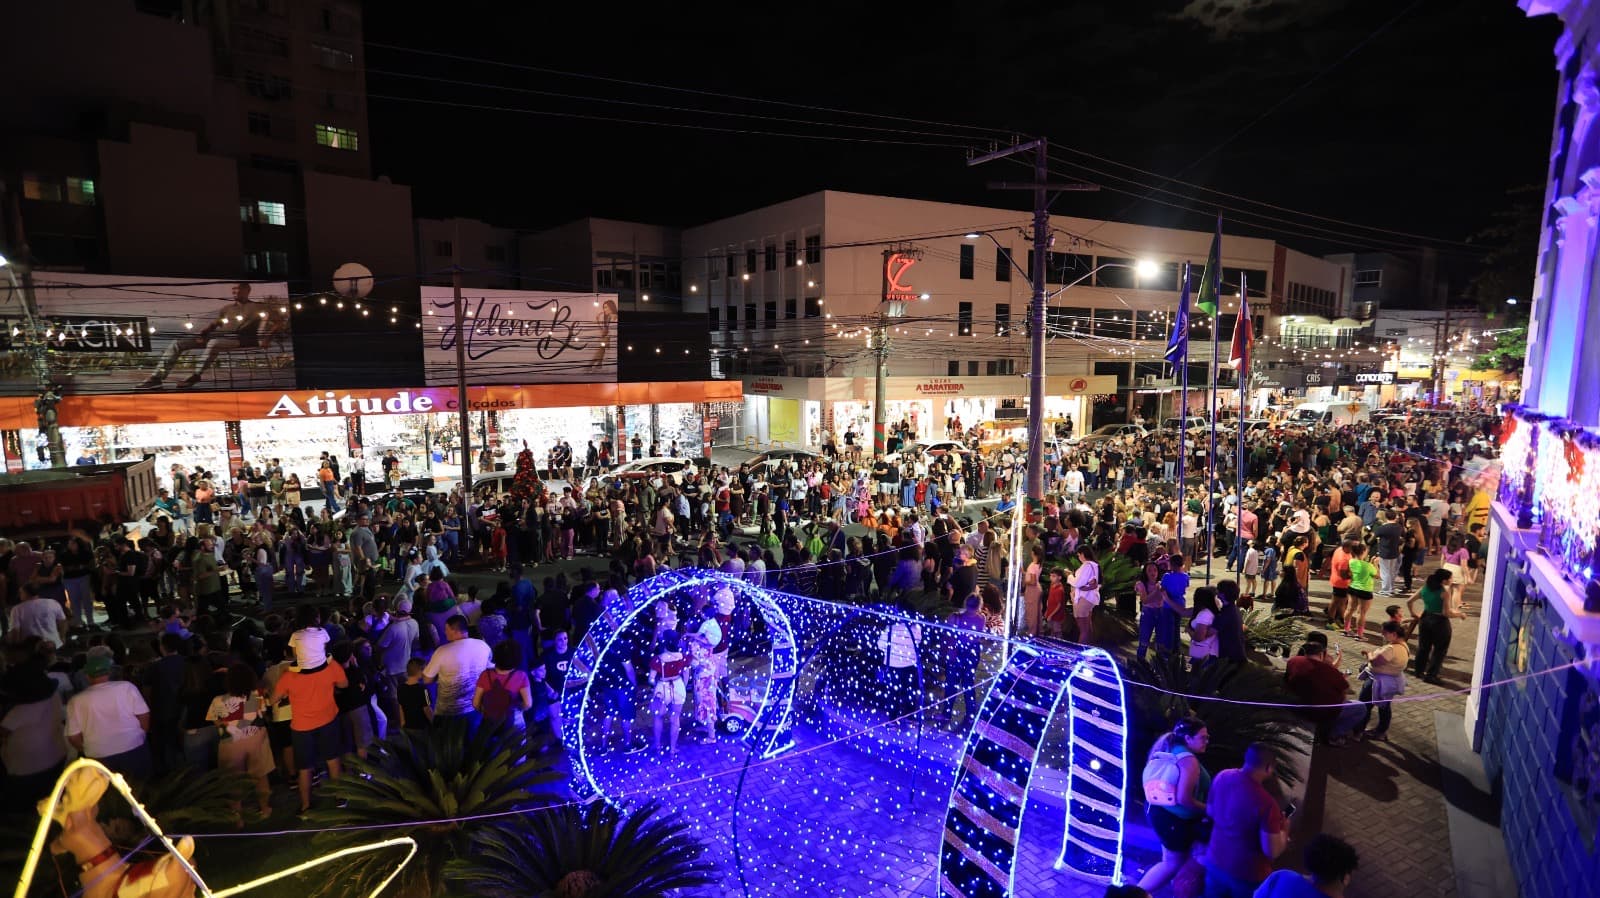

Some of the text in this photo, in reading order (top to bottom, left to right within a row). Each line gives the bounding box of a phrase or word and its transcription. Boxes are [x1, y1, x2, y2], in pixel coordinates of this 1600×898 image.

[432, 297, 588, 360] Helena Be
[267, 391, 433, 416] Atitude
[446, 399, 516, 410] Clçados
